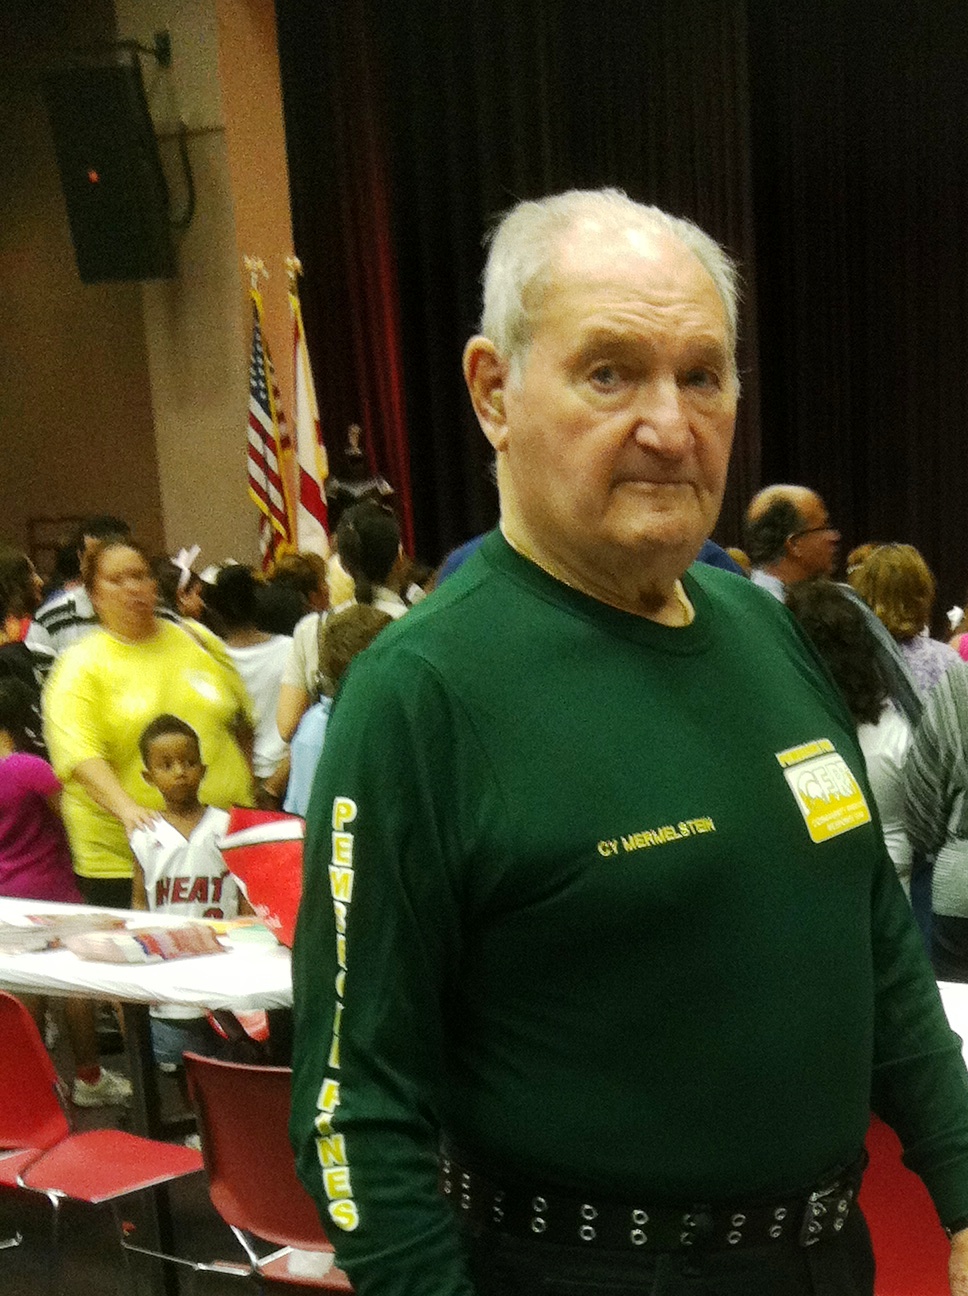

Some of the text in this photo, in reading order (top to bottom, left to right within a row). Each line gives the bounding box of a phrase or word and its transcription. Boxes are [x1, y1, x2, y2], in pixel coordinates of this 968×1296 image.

[597, 816, 717, 857] CY MERMELSTEIN
[155, 870, 231, 907] HEAT
